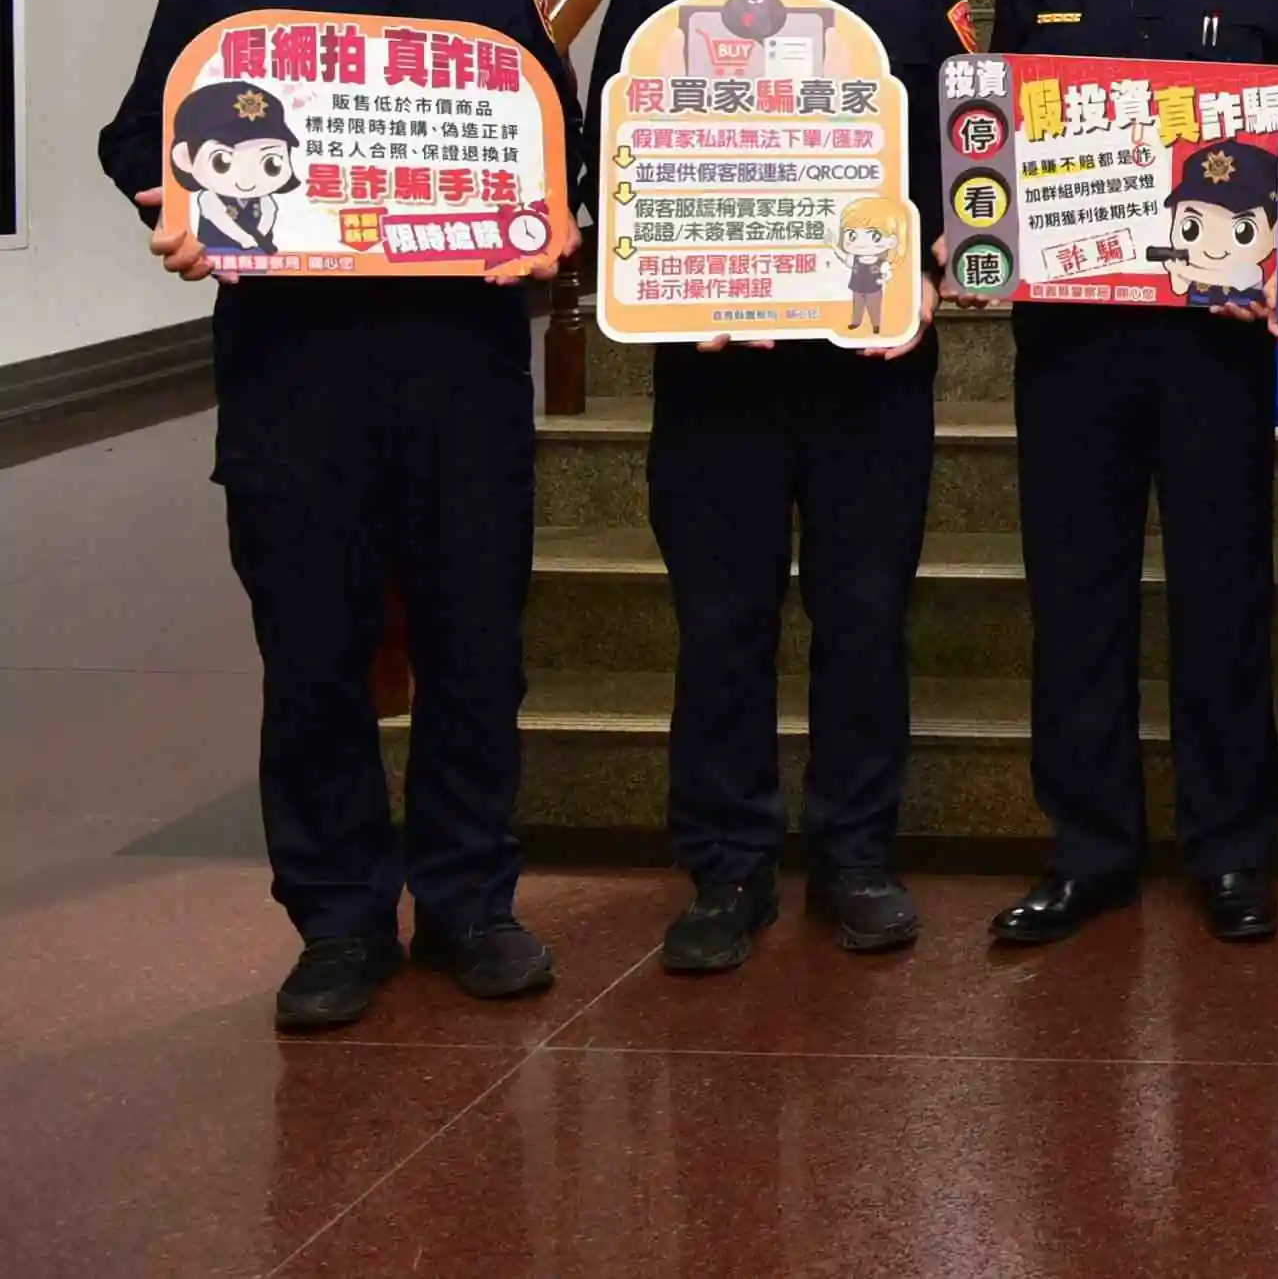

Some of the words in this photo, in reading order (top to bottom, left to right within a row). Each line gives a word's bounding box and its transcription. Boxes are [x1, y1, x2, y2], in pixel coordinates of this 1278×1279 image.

[221, 25, 367, 82] 假網拍
[384, 26, 521, 93] 真詐騙
[717, 42, 753, 59] BUY
[626, 77, 879, 115] 假買家騙賣家
[945, 60, 1007, 99] 投資
[332, 94, 492, 116] 販售低於市價商品
[306, 140, 518, 163] 與名人合照、保證退換貨
[960, 117, 997, 151] 停
[306, 163, 518, 202] 是詐騙手法
[963, 185, 997, 220] 看
[1028, 201, 1158, 230] 初期獲利後期失利
[965, 252, 1001, 287] 聽
[1056, 237, 1124, 273] 詐騙
[637, 278, 772, 300] 指示操作網銀
